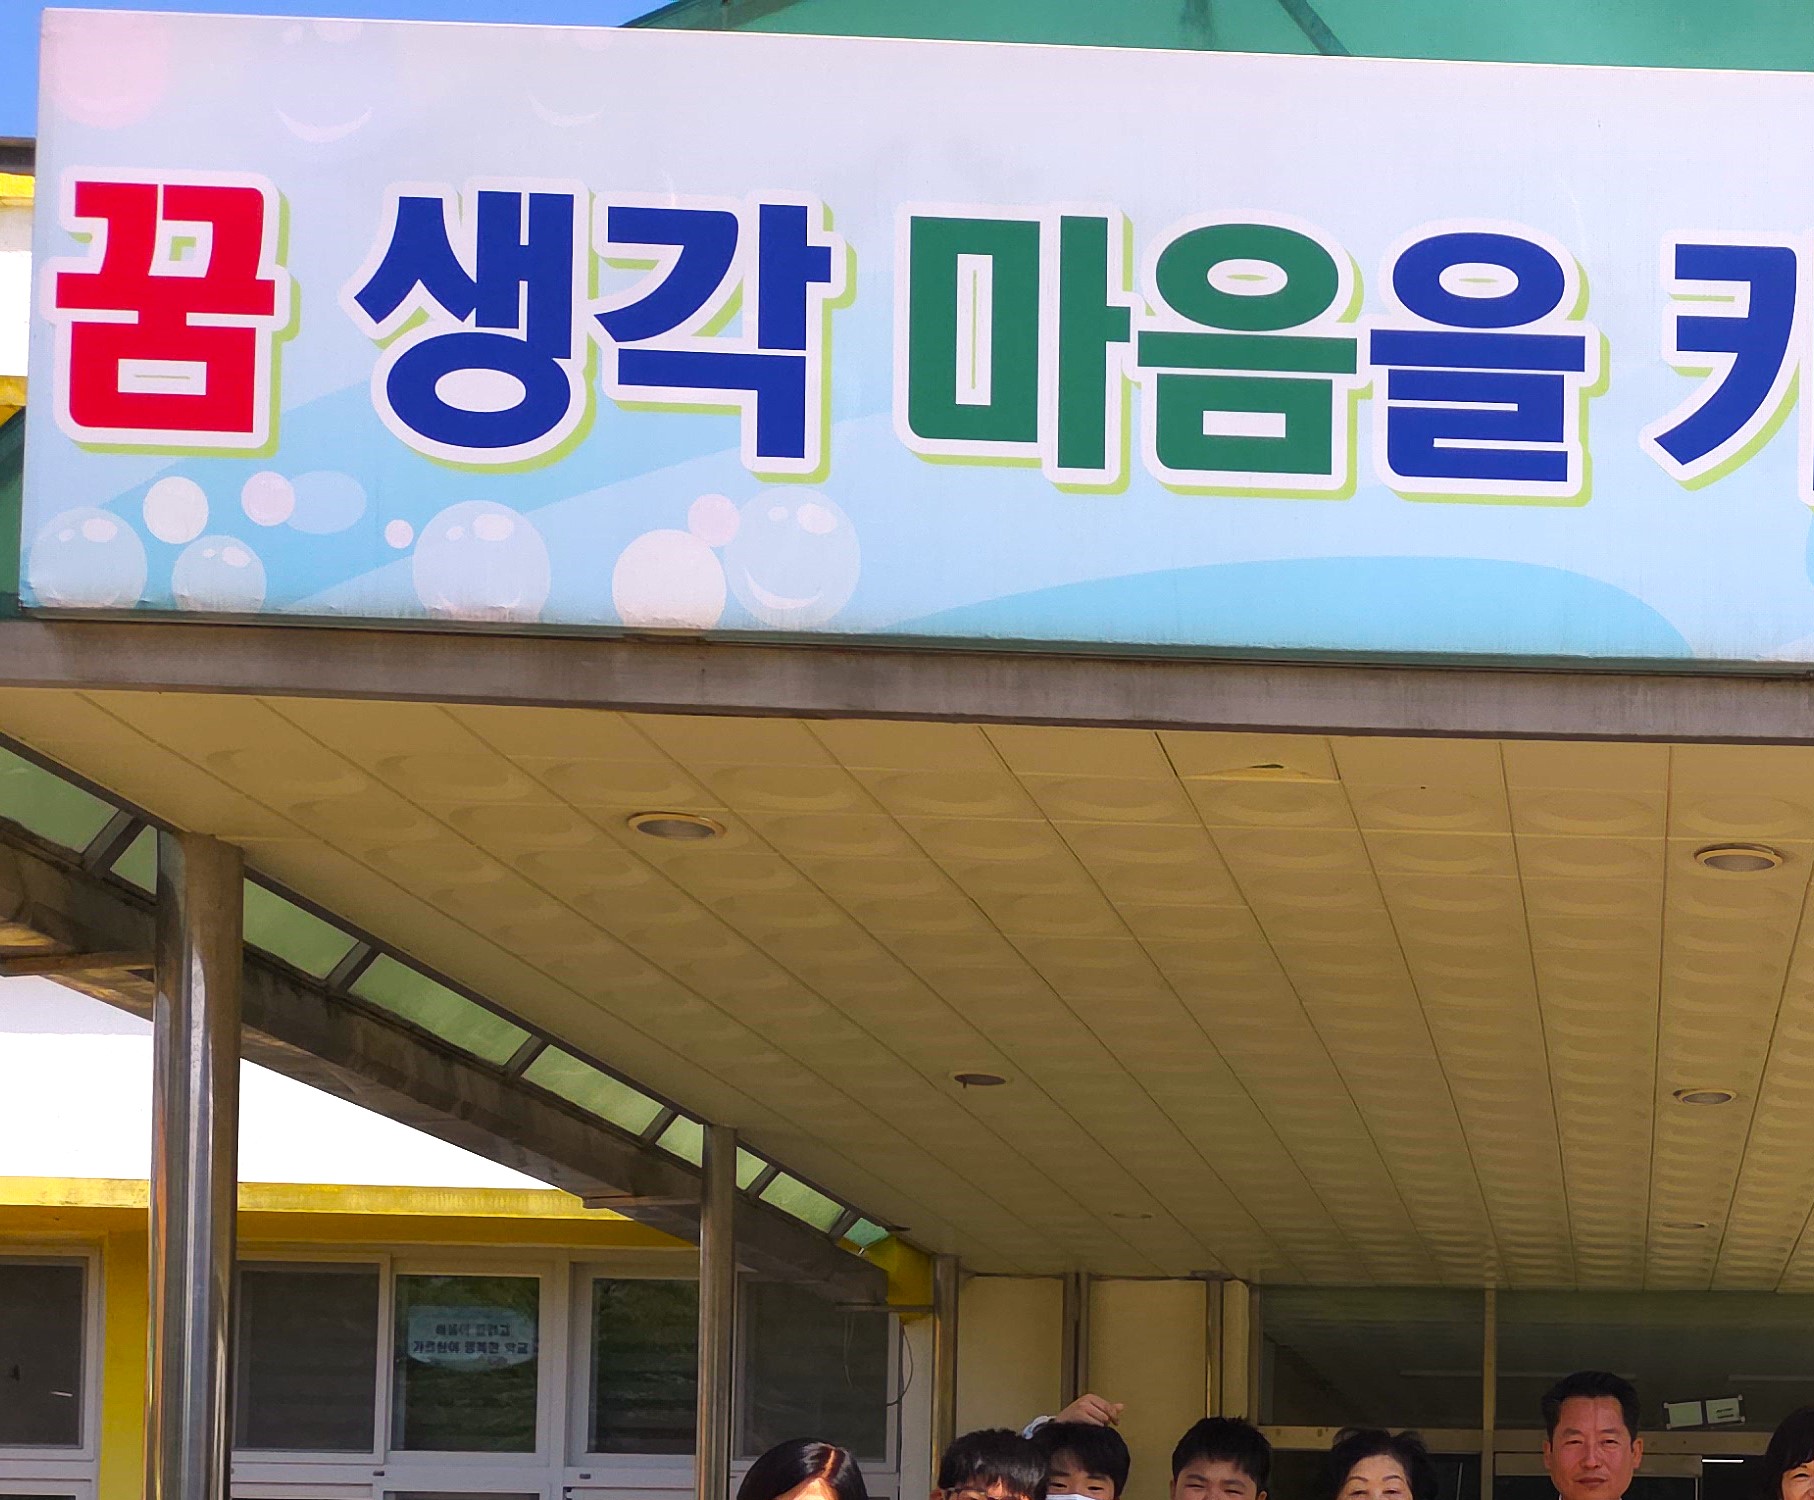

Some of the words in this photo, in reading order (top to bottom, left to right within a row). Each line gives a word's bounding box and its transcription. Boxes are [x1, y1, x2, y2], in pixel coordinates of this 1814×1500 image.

[60, 186, 274, 432] 꿈
[355, 191, 830, 458] 생각
[912, 220, 1584, 481] 마음을
